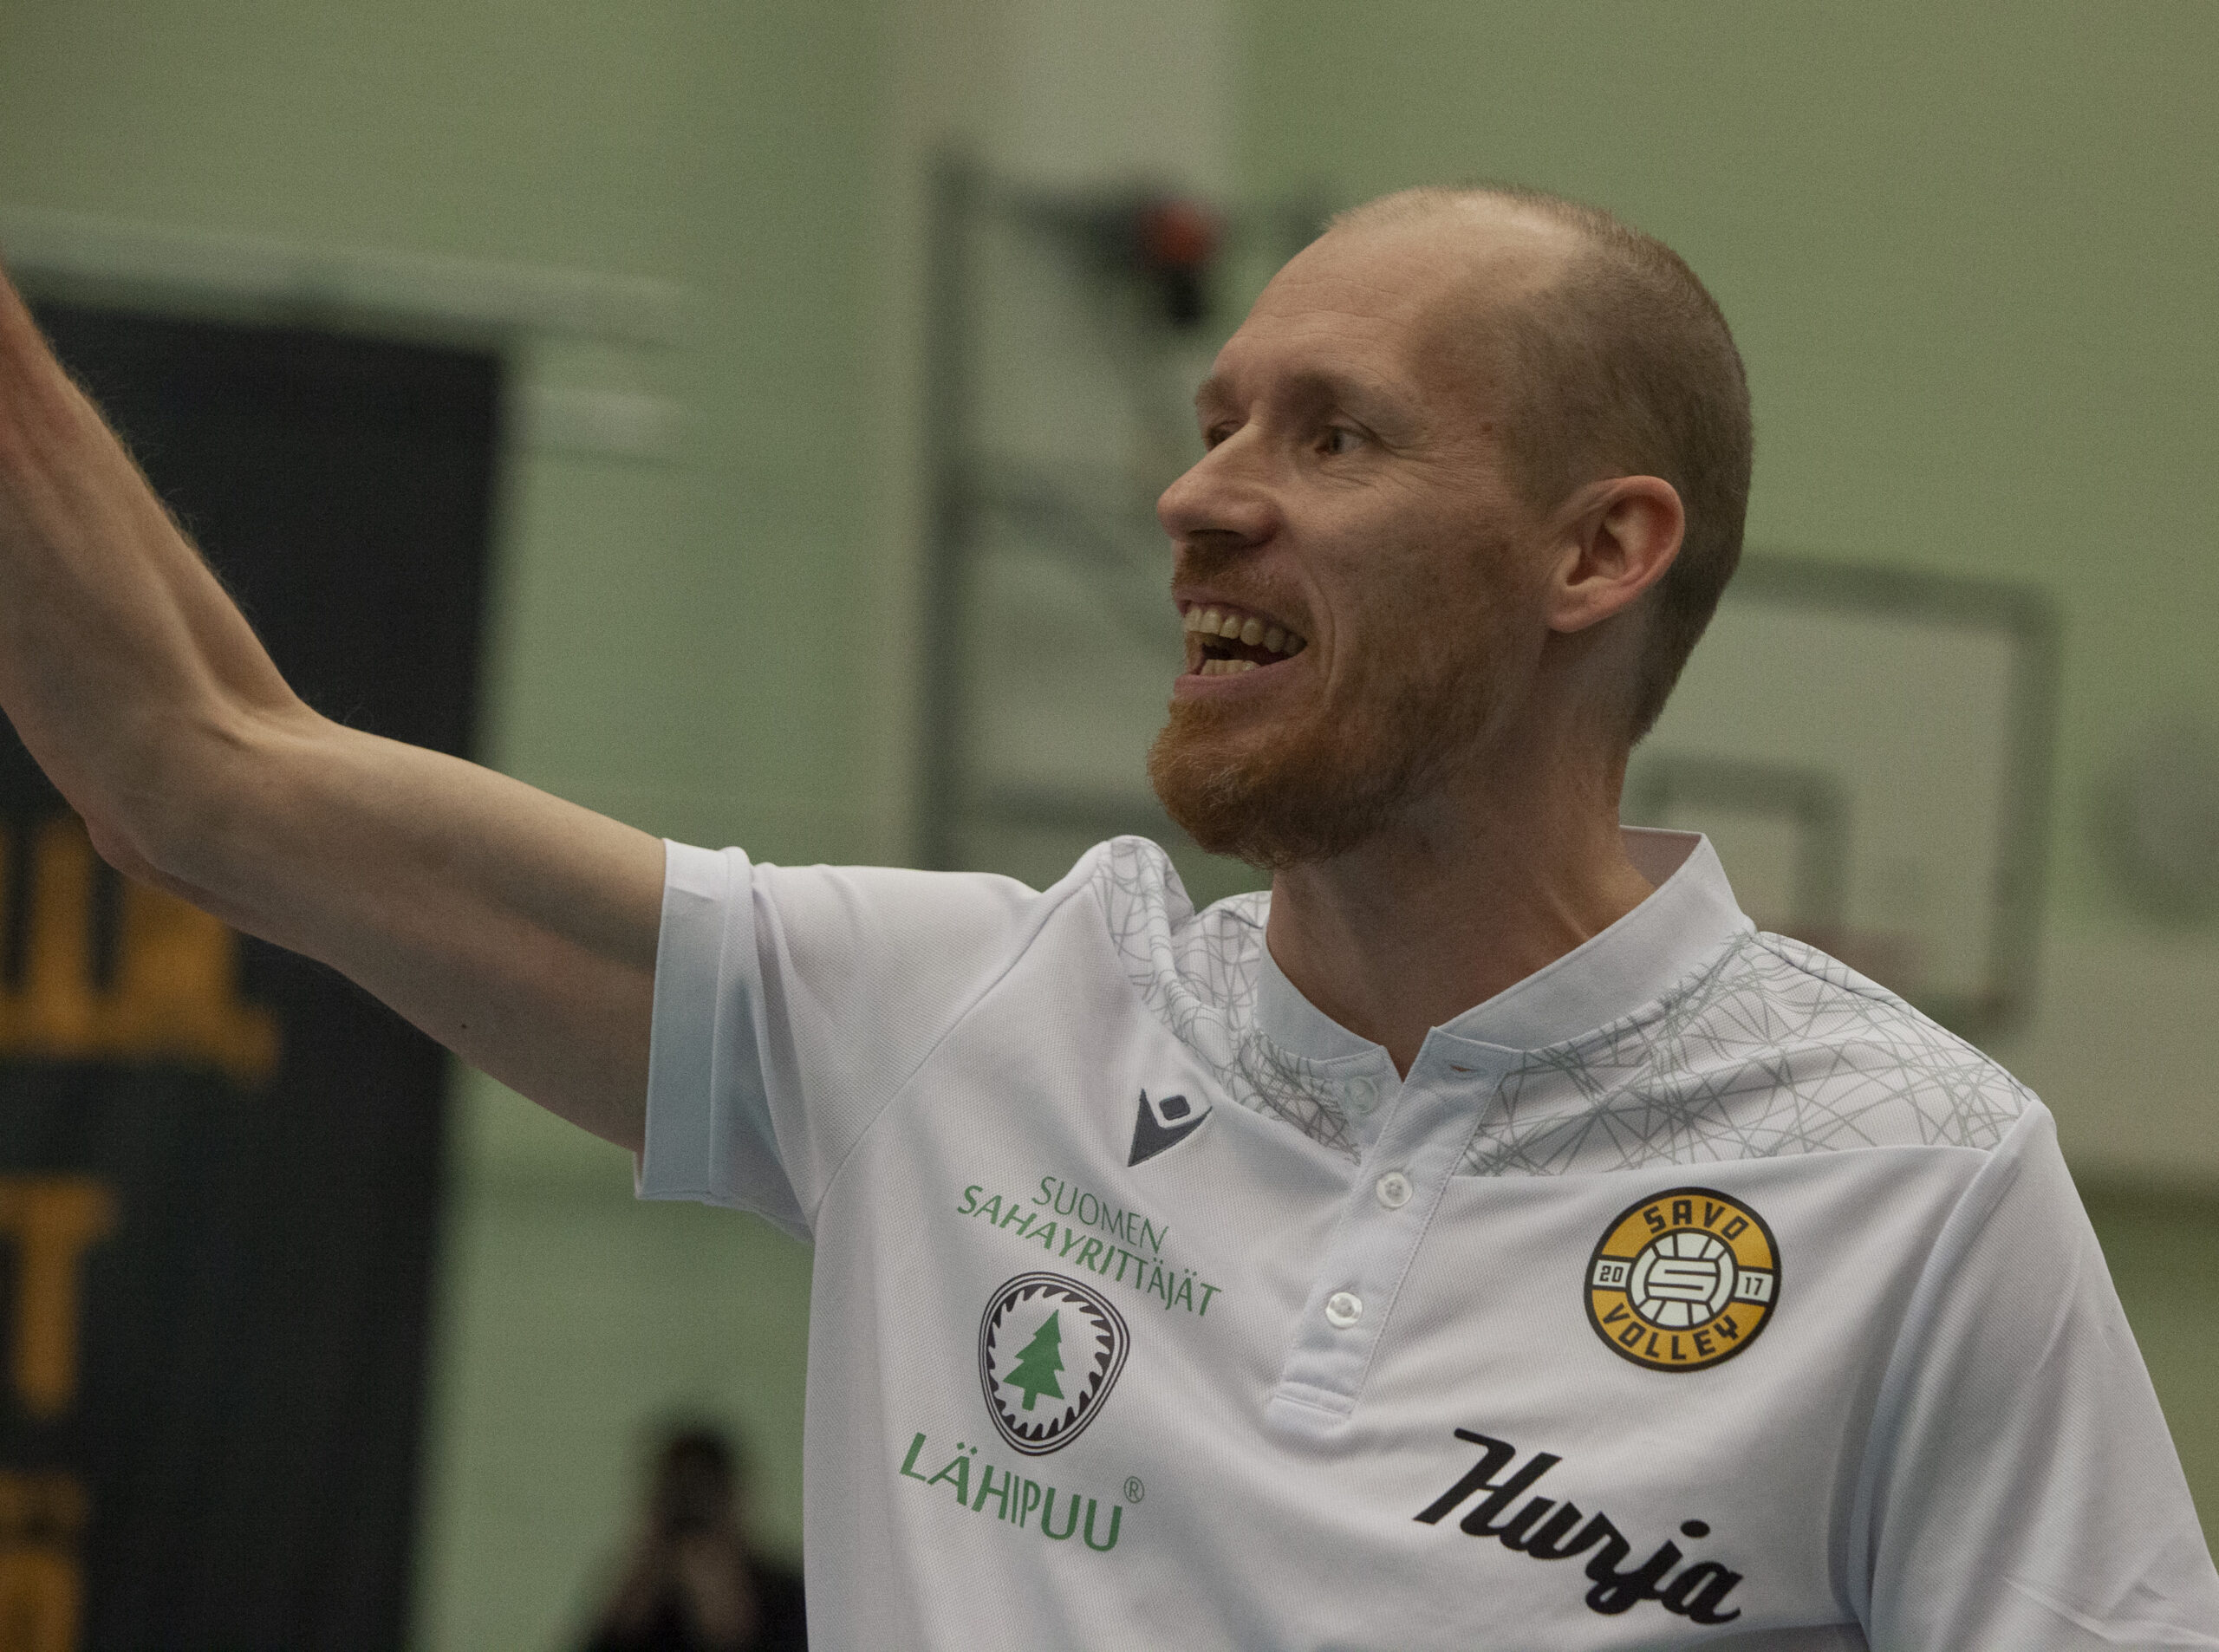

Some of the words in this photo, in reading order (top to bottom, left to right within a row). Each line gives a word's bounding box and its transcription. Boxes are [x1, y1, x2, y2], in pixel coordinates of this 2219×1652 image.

[1031, 1175, 1168, 1254] SUOMEN
[1643, 1199, 1750, 1241] SAVO
[957, 1184, 1222, 1317] SAHAYRITTÄJÄT
[1599, 1265, 1624, 1283] 20
[1745, 1277, 1764, 1296] 17
[1603, 1302, 1739, 1361] VOLLEY
[899, 1432, 1123, 1551] LÄHIPUU
[1412, 1428, 1743, 1625] Hurja
